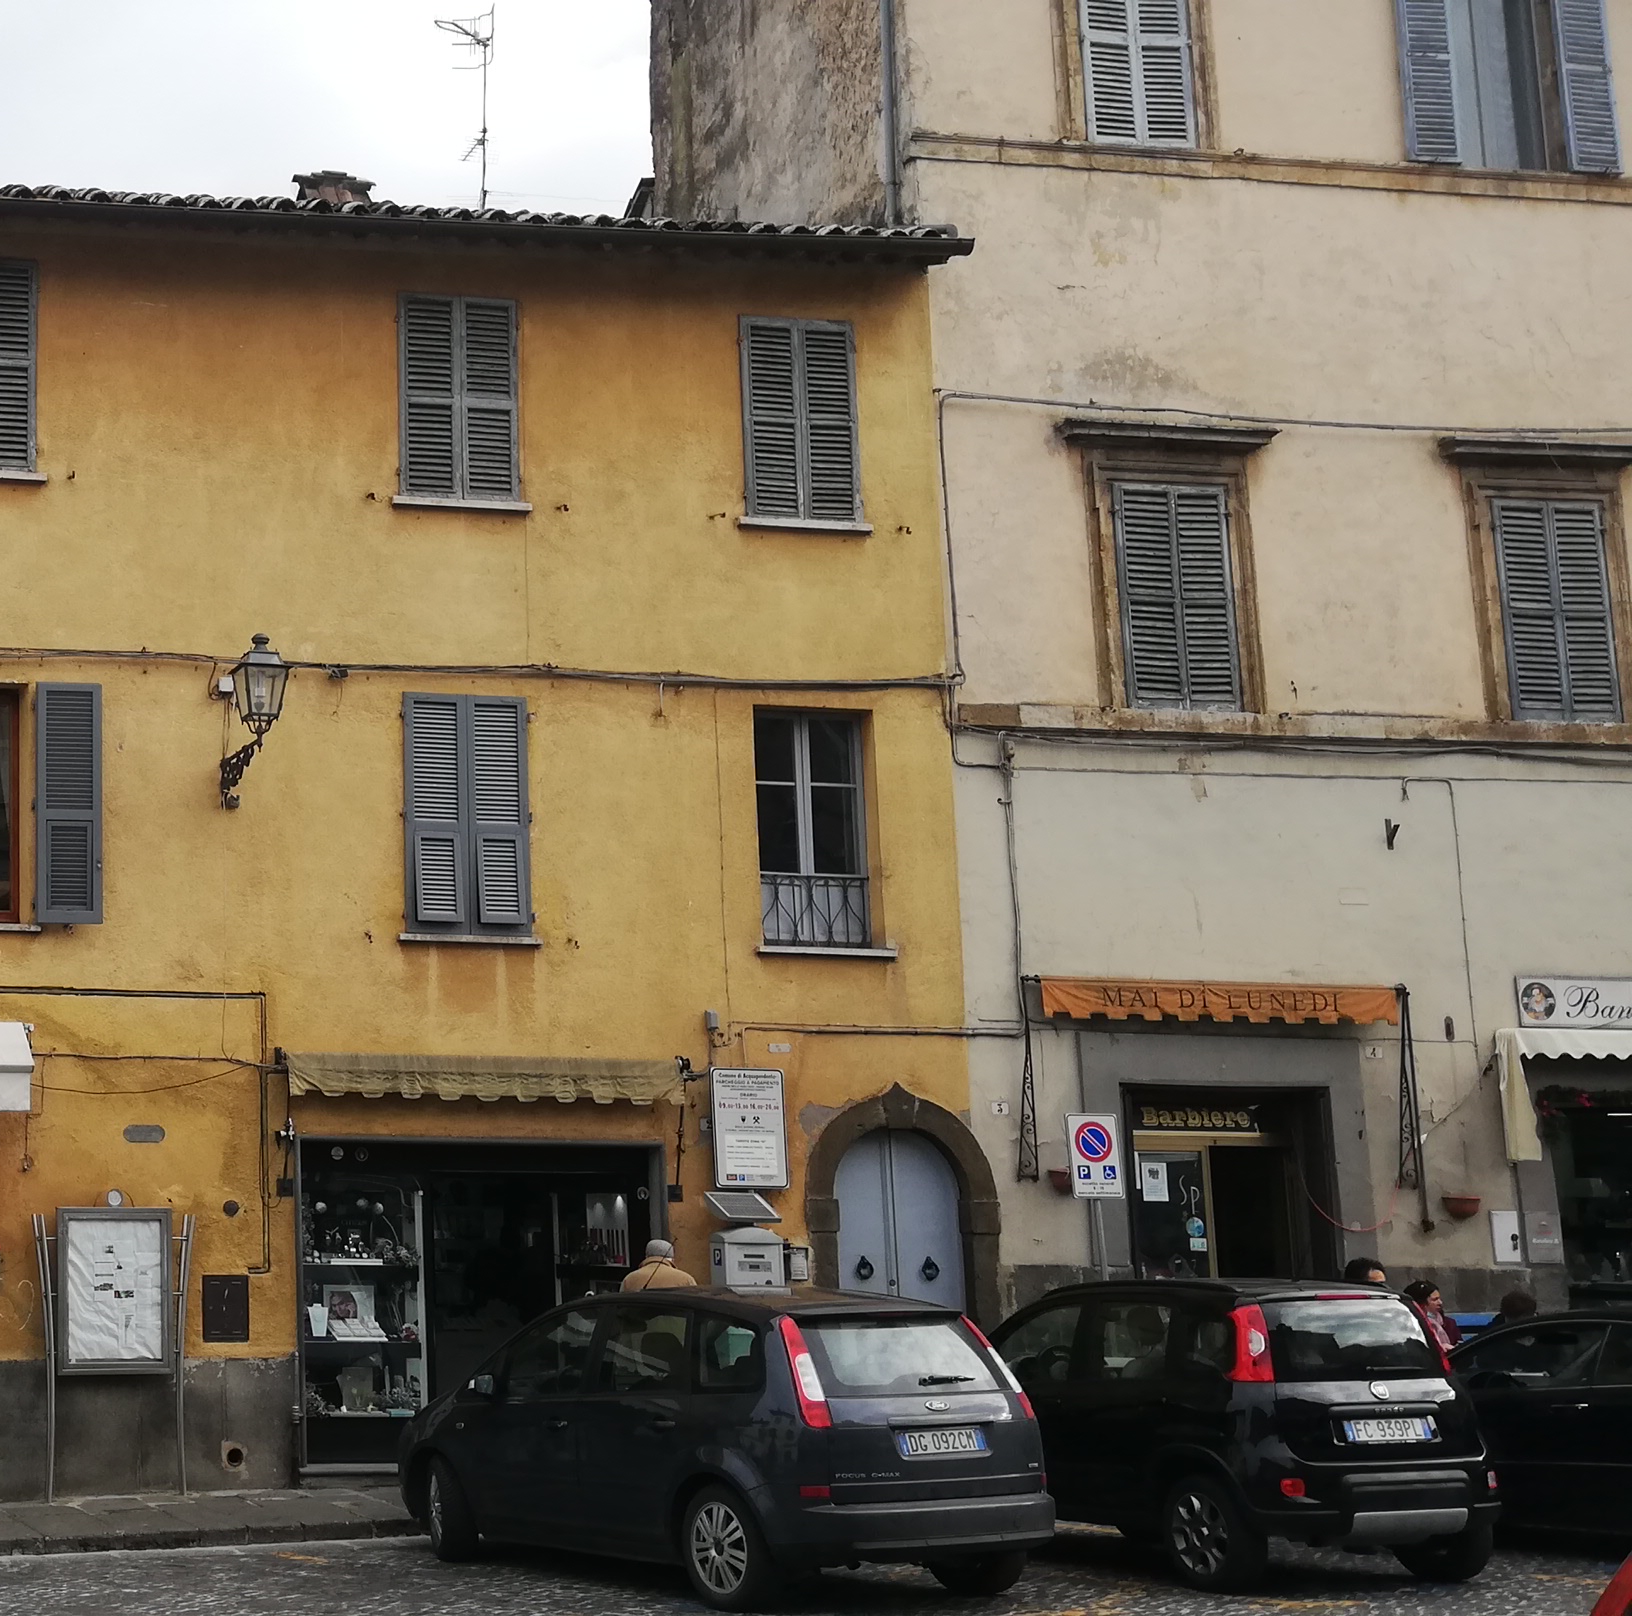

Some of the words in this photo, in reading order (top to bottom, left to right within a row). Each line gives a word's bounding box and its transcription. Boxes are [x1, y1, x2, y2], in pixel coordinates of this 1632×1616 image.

[1225, 989, 1340, 1013] LUNEDI
[1141, 1106, 1250, 1128] Barbiere
[1080, 1167, 1088, 1178] P
[908, 1433, 928, 1453] DG
[932, 1429, 977, 1451] 092CM
[1353, 1421, 1374, 1441] FC
[1376, 1419, 1423, 1439] 939PL
